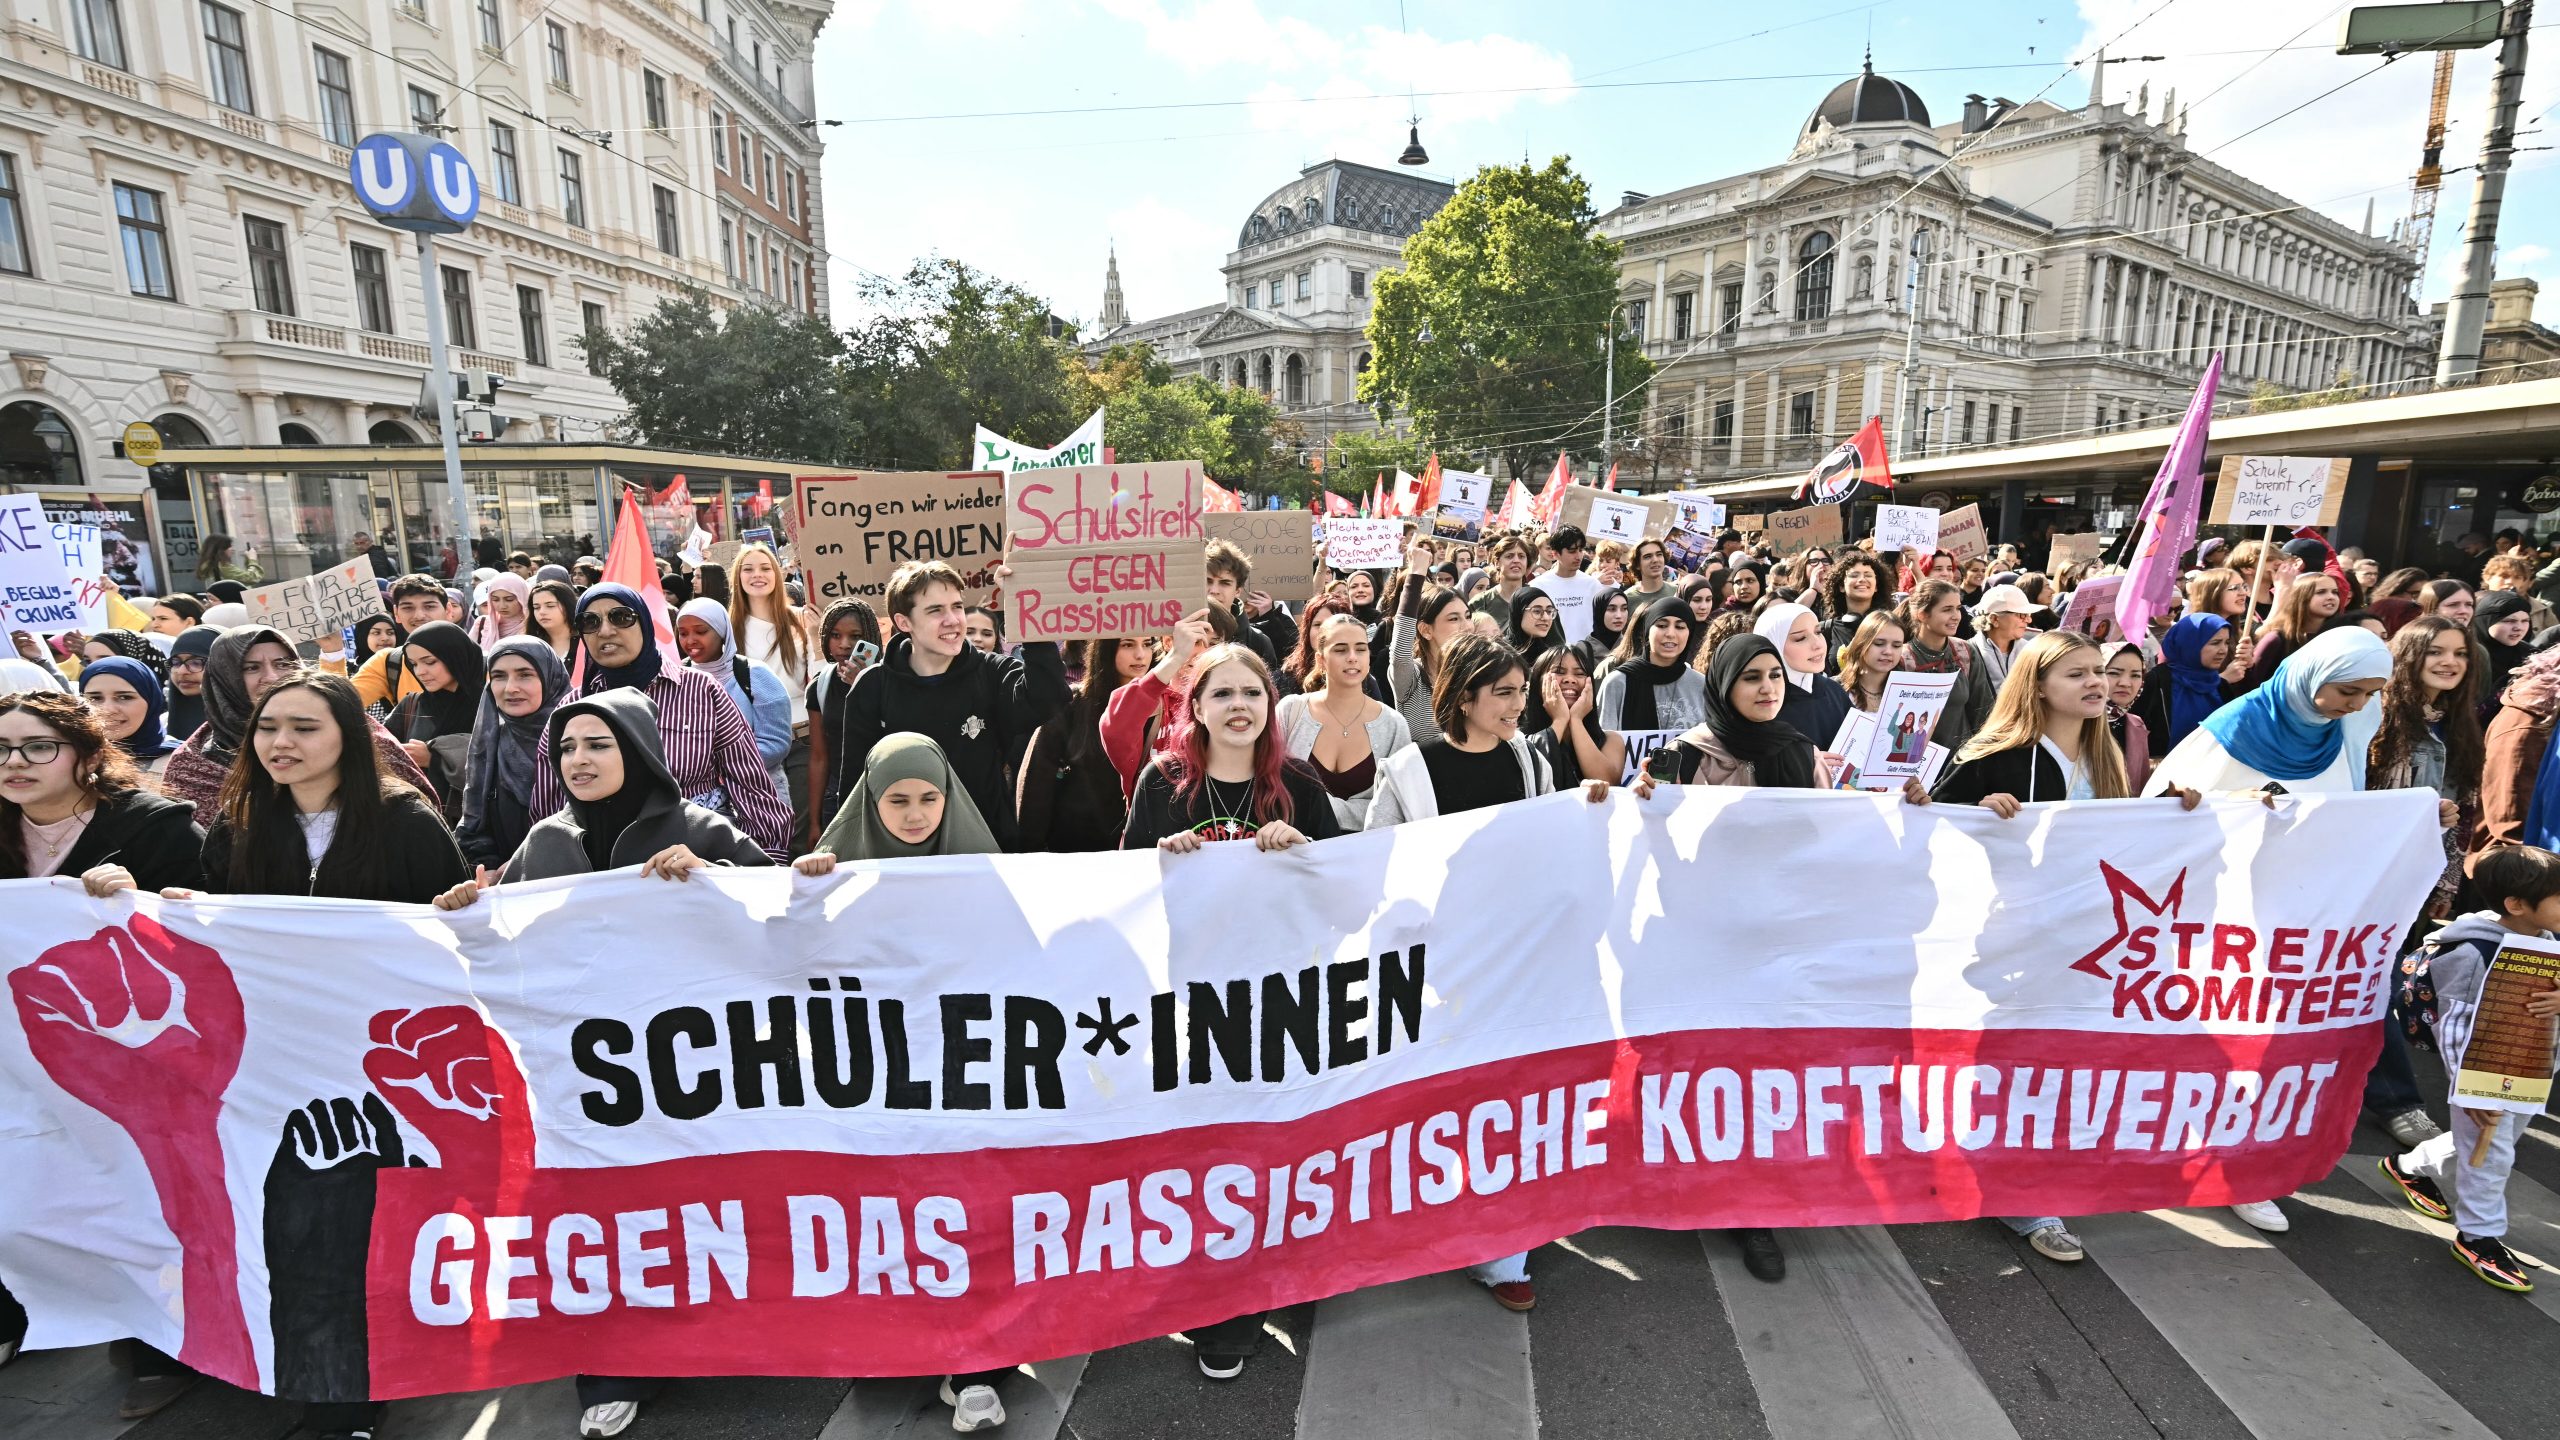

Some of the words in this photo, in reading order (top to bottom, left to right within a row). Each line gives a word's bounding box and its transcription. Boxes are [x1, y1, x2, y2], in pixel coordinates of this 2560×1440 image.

[358, 148, 409, 206] U
[430, 153, 472, 215] U
[128, 441, 159, 449] CORSO
[807, 487, 904, 528] Fangen
[912, 494, 938, 512] wir
[945, 487, 1002, 511] wieder
[1014, 468, 1203, 548] Schulstreik
[2238, 492, 2272, 506] Politik
[80, 511, 135, 522] MUEHL
[1776, 515, 1810, 529] GEGEN
[1915, 511, 1929, 519] THE
[2246, 504, 2282, 521] pennt
[1329, 521, 1360, 531] Heute
[816, 543, 843, 555] an
[863, 523, 1002, 564] FRAUEN
[1329, 533, 1373, 546] morgen
[1329, 543, 1391, 559] Übermorgen
[1068, 552, 1165, 594] GEGEN
[822, 571, 886, 597] etwas
[1016, 589, 1182, 640] Rassismus
[2119, 922, 2378, 973] STREIK
[2498, 951, 2510, 959] DIE
[2510, 953, 2543, 965] REICHEN
[2493, 961, 2506, 970] DIE
[2505, 963, 2537, 975] JUGEND
[2537, 968, 2556, 978] EINE
[2112, 970, 2362, 1024] KOMITEE
[409, 1199, 749, 1326] GEGEN
[786, 1194, 970, 1298] DAS
[1012, 1079, 1609, 1287] RASSISTISCHE
[1641, 1061, 2339, 1164] KOPFTUCHVERBOT
